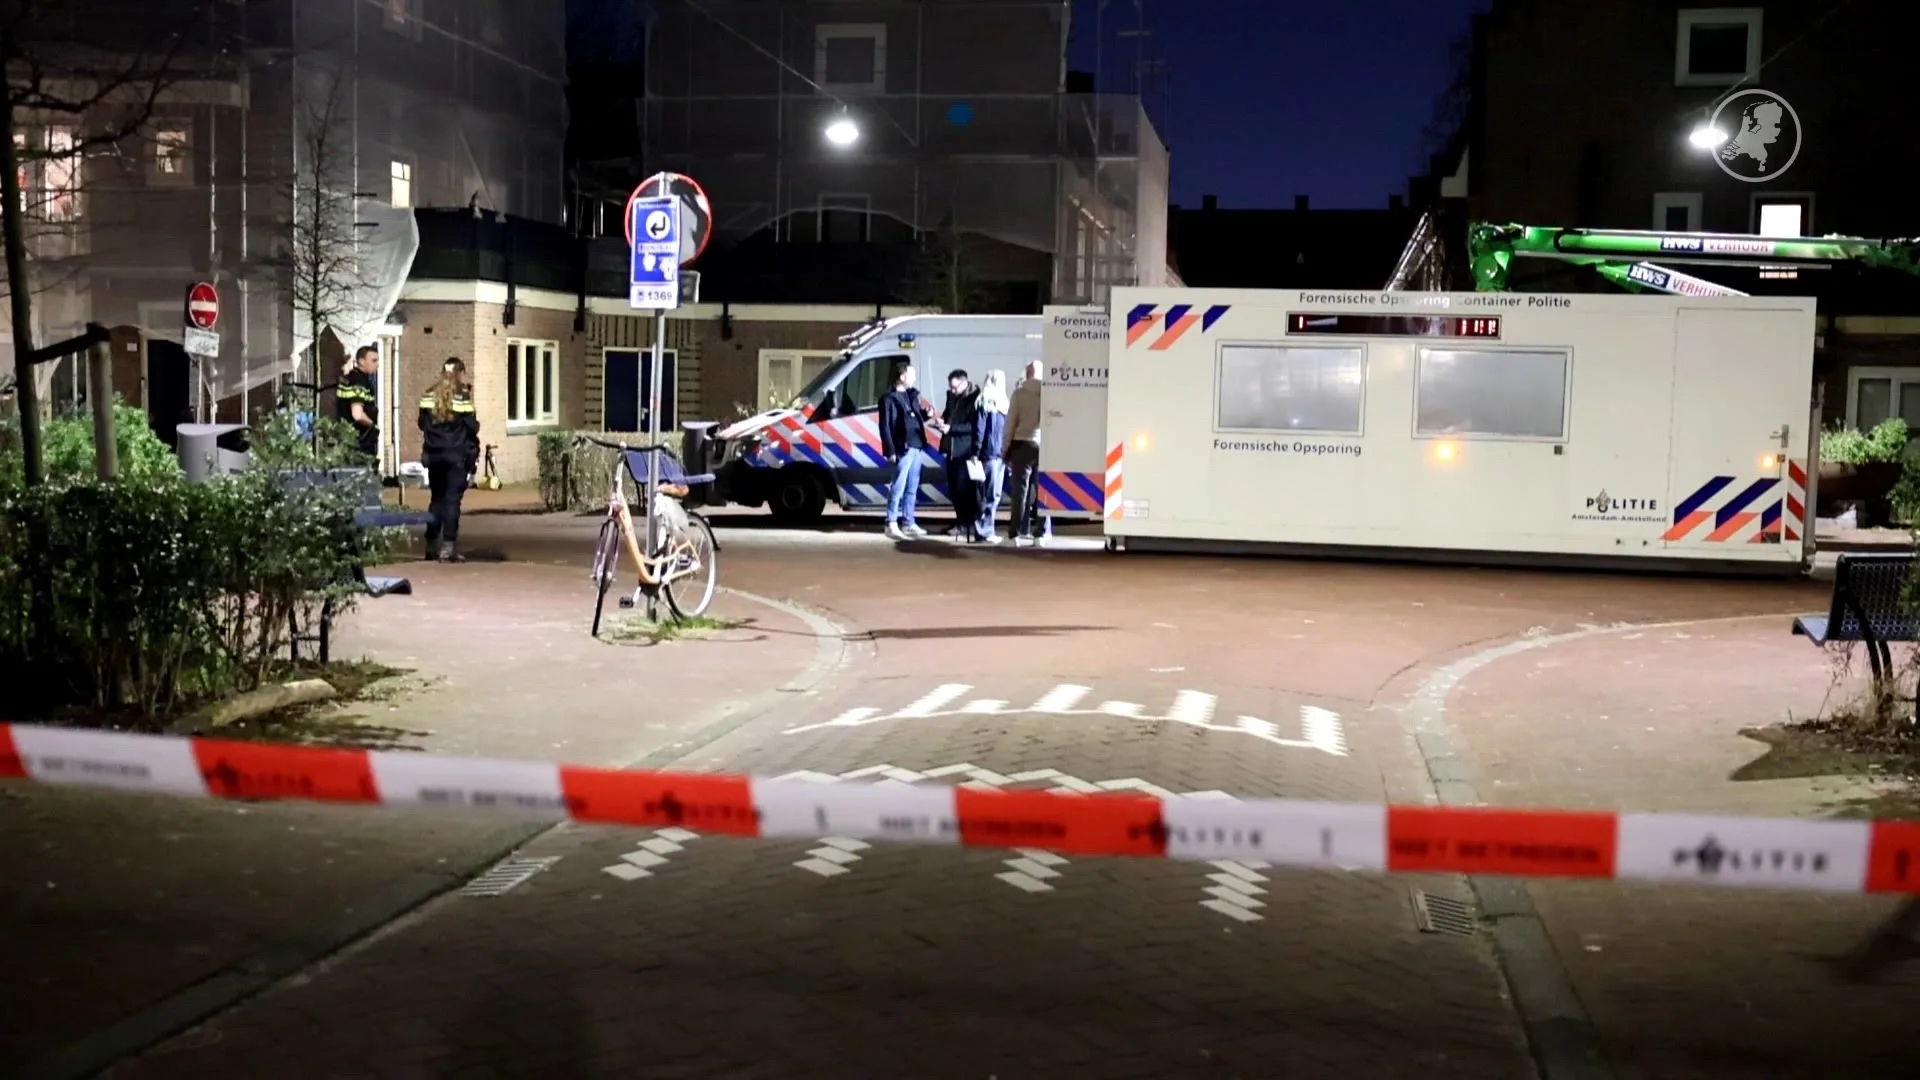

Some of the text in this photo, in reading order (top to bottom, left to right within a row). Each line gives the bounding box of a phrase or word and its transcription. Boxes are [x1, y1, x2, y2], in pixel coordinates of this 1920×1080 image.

[1629, 264, 1667, 287] HWS
[1299, 292, 1376, 304] Forensische
[1528, 296, 1571, 307] Politie
[1213, 439, 1362, 457] Forensische Opsporing
[1586, 491, 1657, 513] POLITIE
